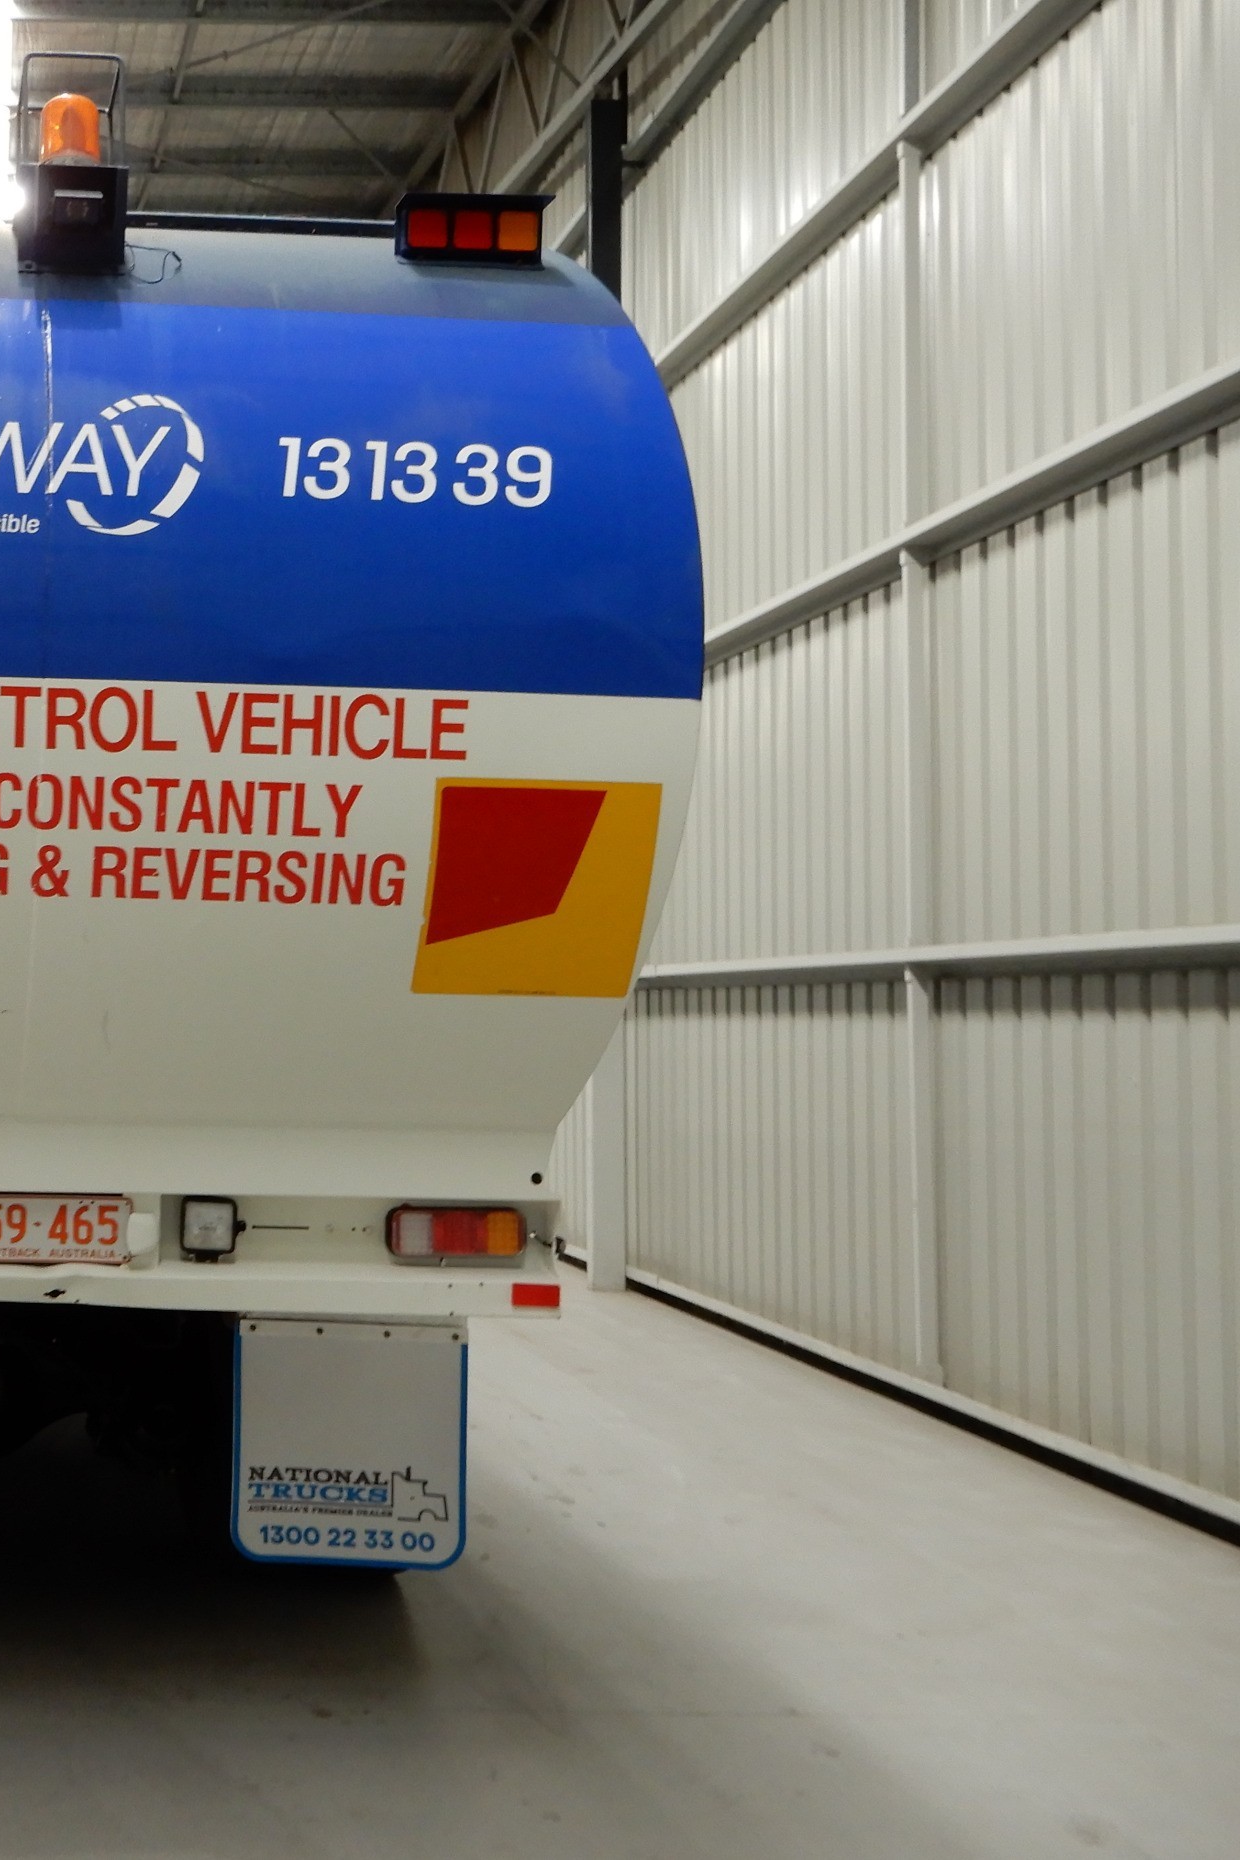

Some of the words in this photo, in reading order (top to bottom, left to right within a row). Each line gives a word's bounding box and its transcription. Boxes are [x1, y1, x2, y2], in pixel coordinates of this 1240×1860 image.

[278, 436, 352, 500] 13
[365, 440, 439, 503] 13
[452, 443, 553, 508] 39
[196, 690, 469, 761] VEHICLE
[31, 844, 69, 898] &
[91, 845, 407, 907] REVERSING
[248, 1466, 389, 1486] NATIONAL
[248, 1483, 388, 1504] TRUCKS
[260, 1524, 321, 1545] 1300
[327, 1528, 357, 1548] 22
[364, 1529, 394, 1549] 33
[400, 1532, 436, 1552] 00
